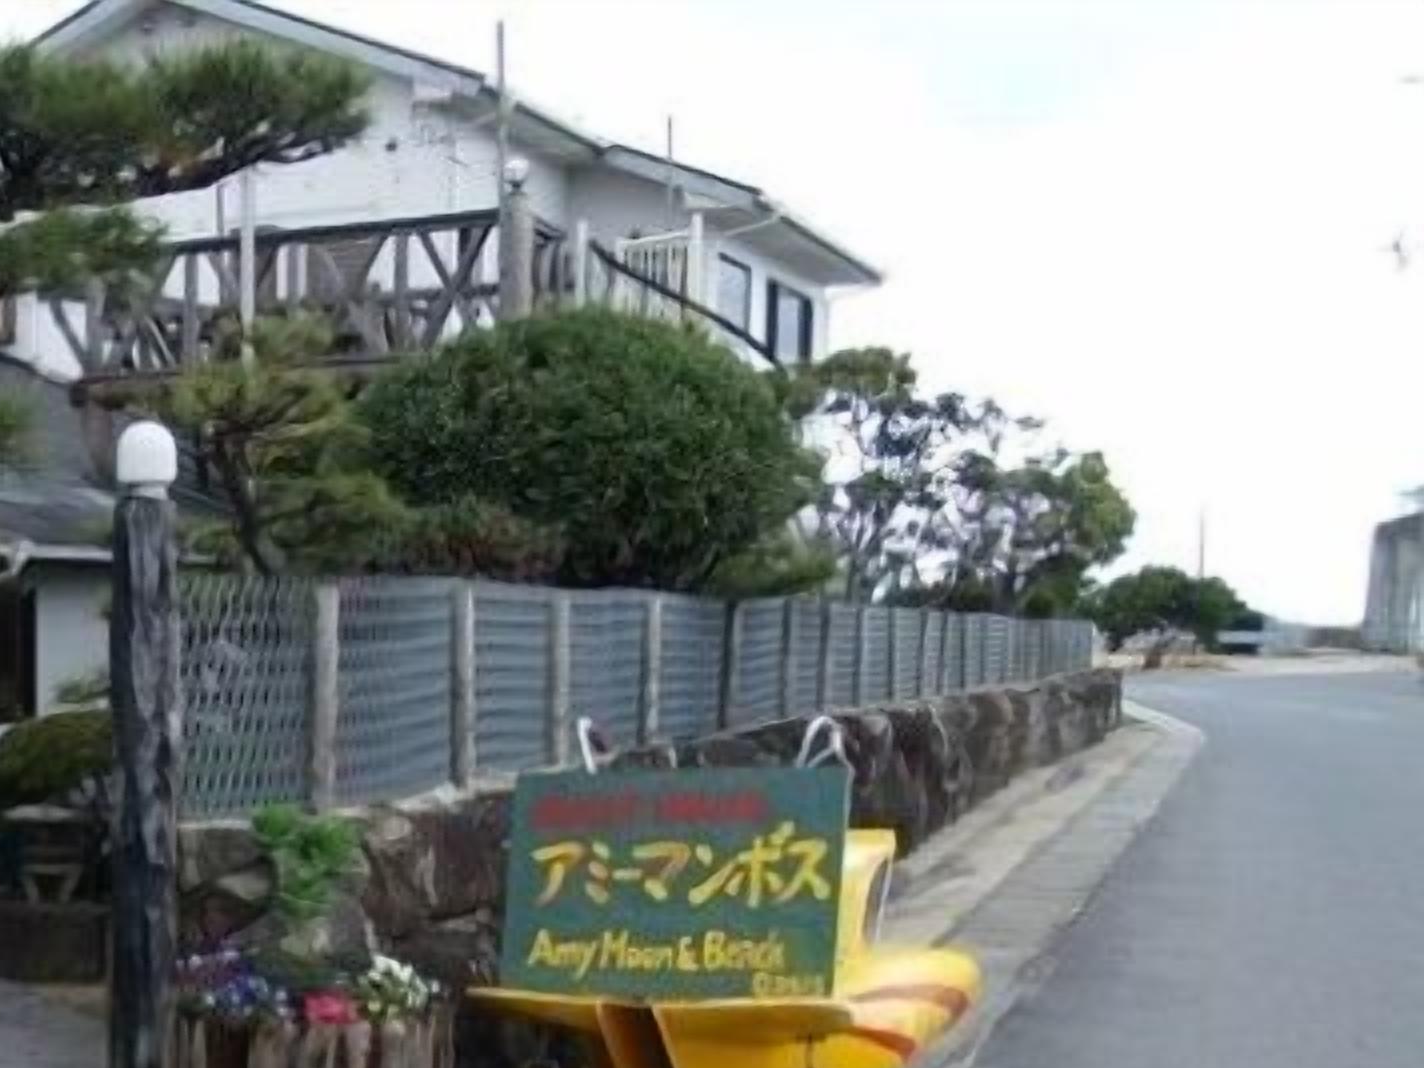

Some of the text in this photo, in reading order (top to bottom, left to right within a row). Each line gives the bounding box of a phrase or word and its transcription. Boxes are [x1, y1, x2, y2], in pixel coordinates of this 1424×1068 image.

[529, 819, 832, 910] アミーマンボス
[527, 927, 599, 982] Amy
[599, 928, 673, 971] Moon
[677, 935, 699, 972] &
